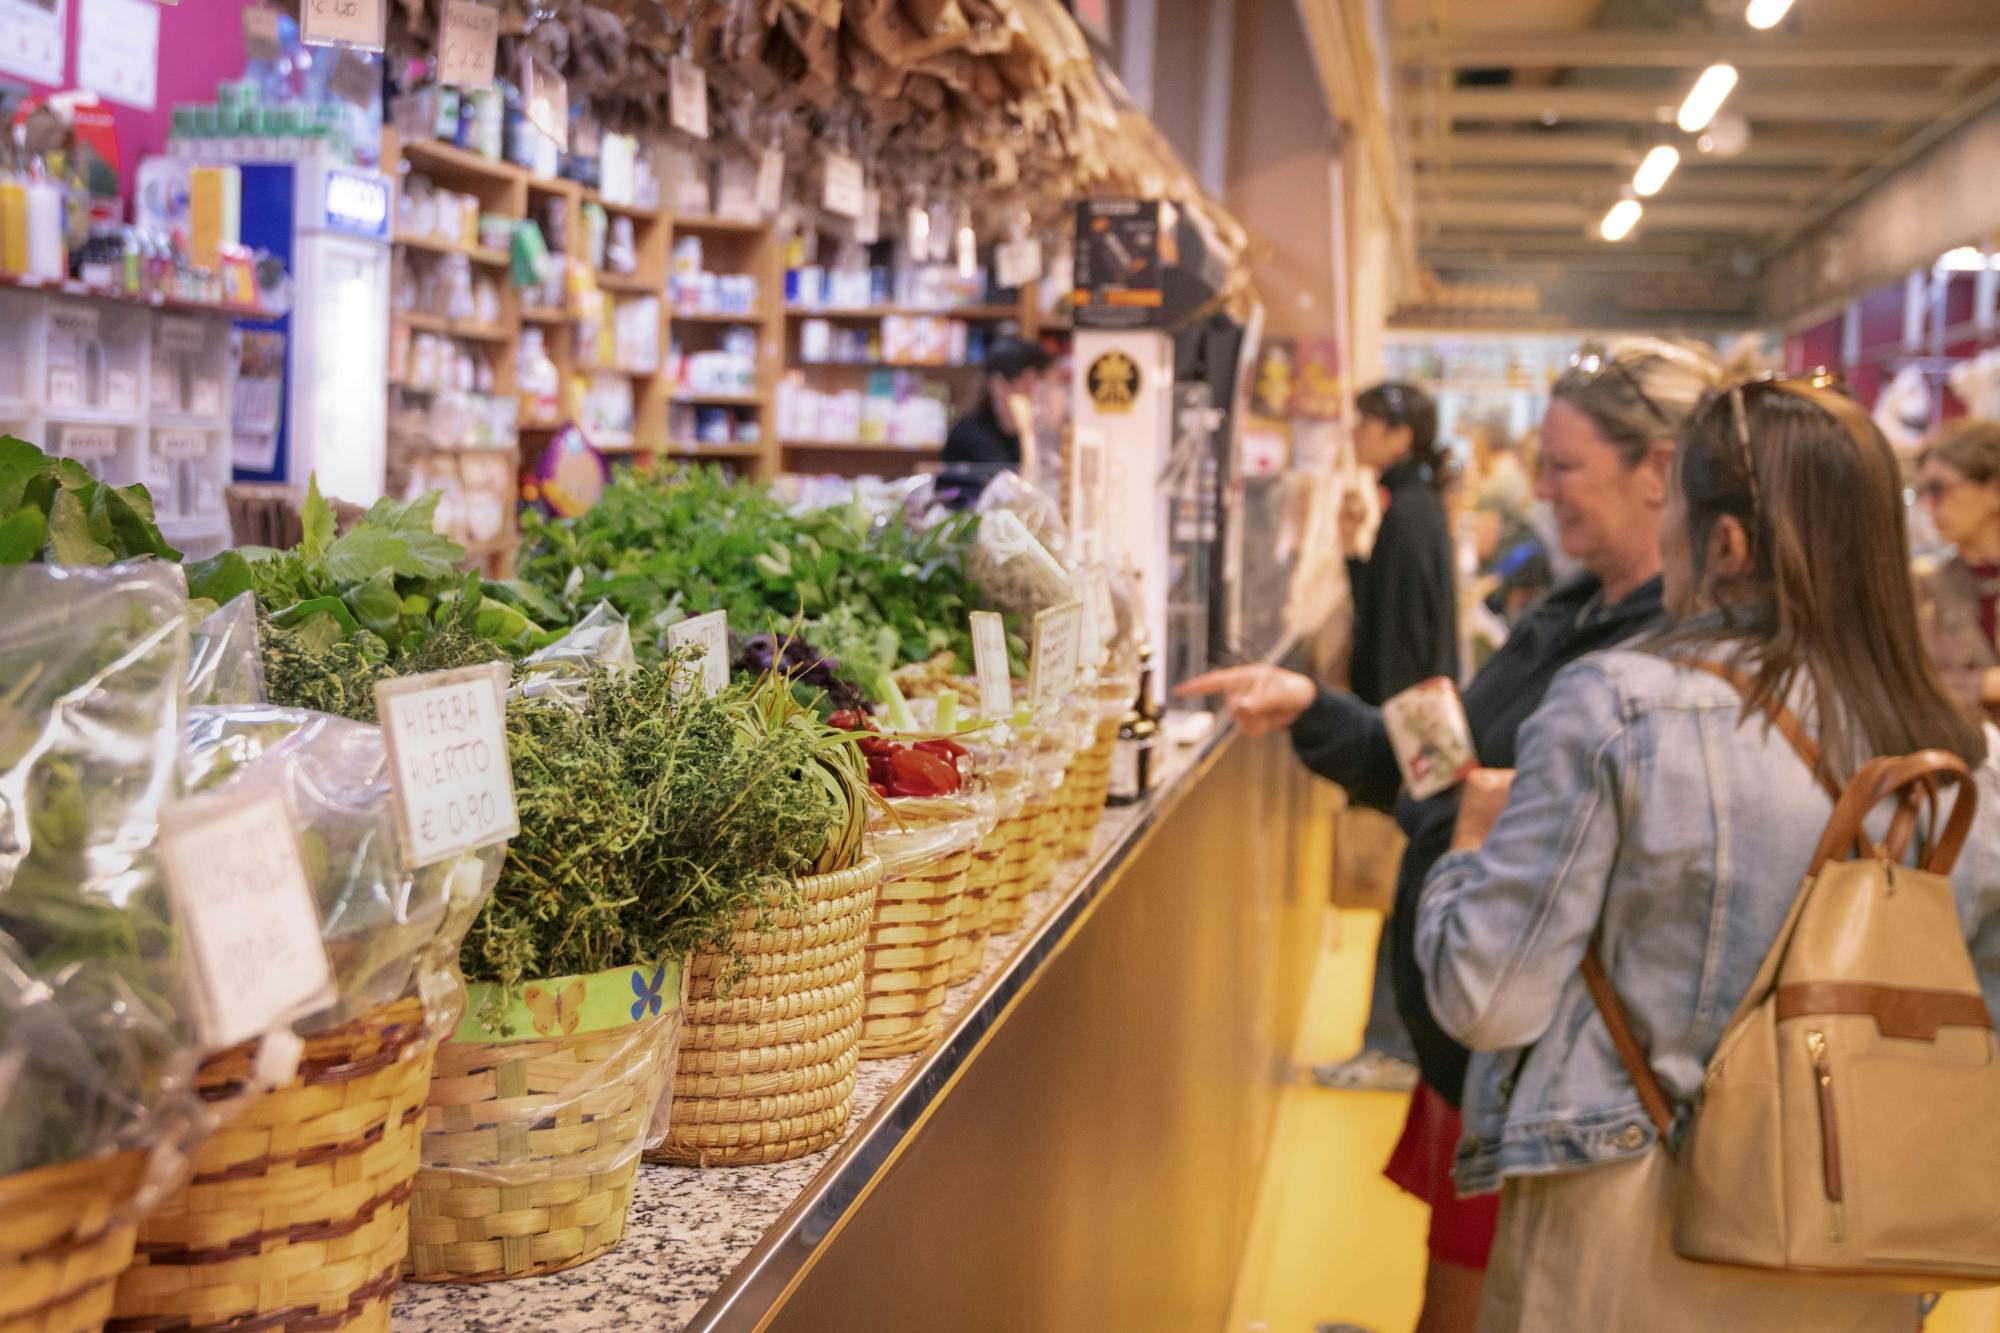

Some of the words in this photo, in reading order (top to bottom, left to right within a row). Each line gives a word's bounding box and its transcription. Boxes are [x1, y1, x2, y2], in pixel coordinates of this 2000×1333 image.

[402, 691, 480, 737] HIERBA
[409, 739, 490, 788] HUERTO
[420, 808, 438, 842] €
